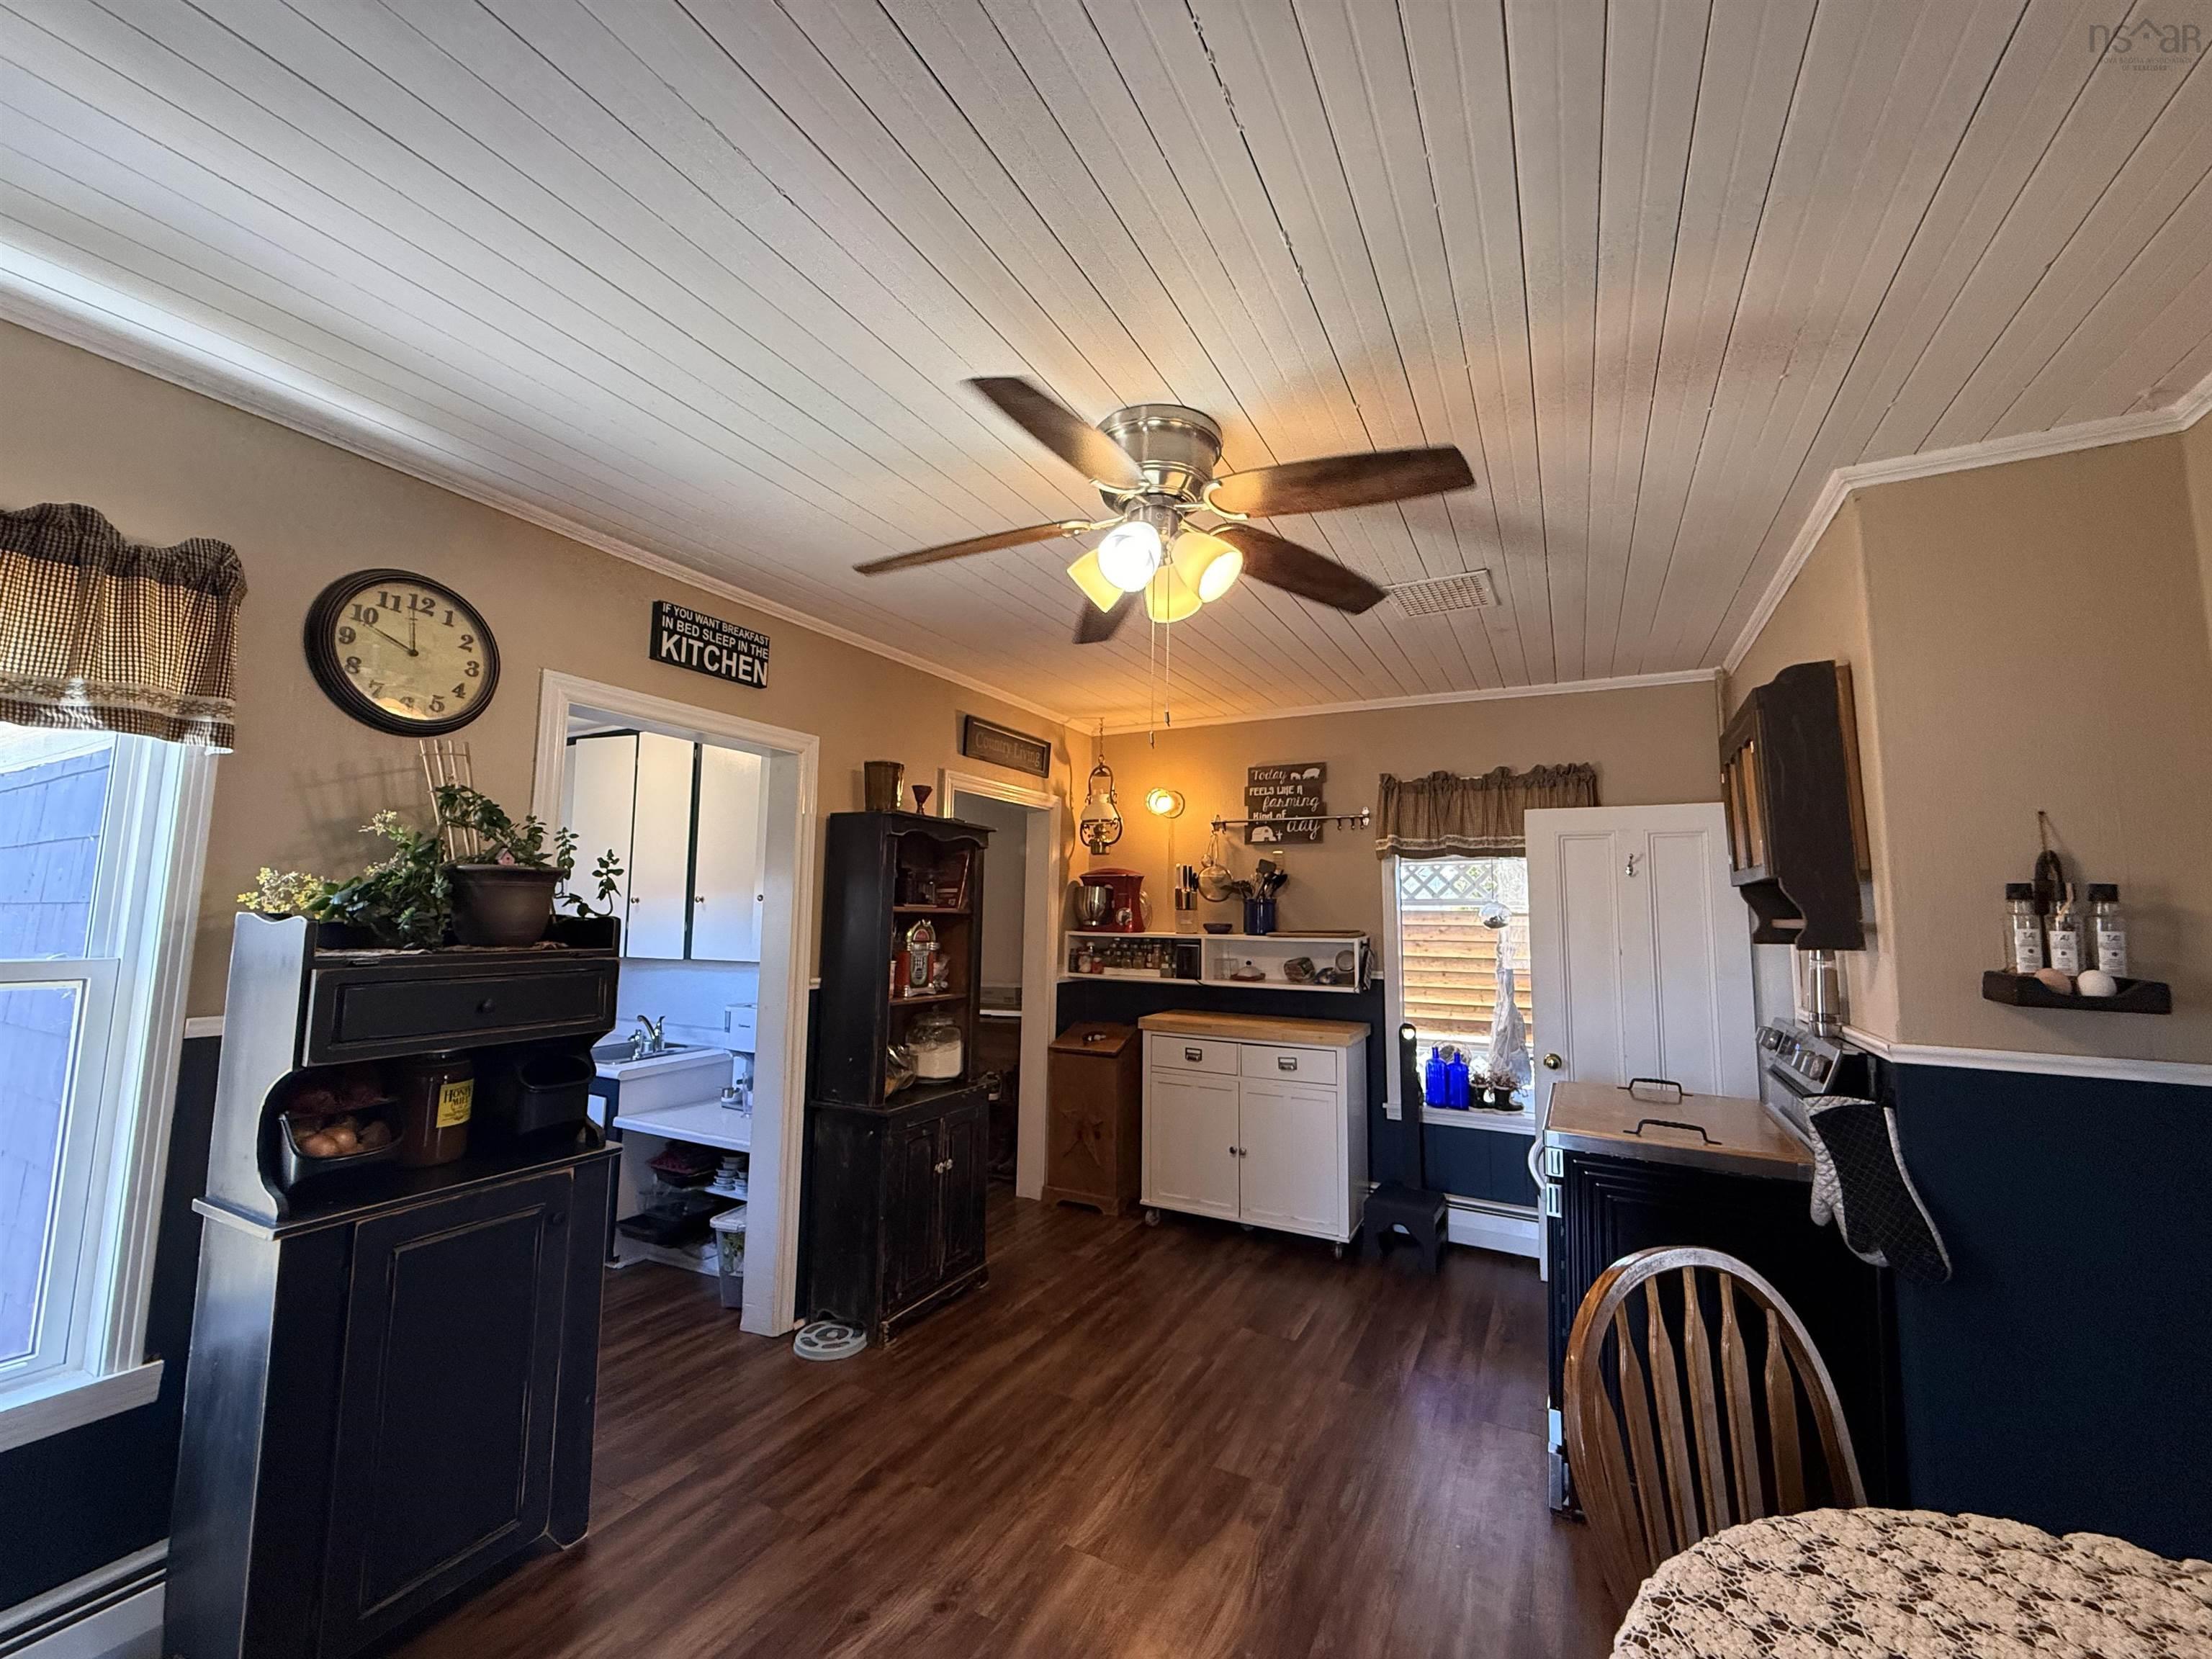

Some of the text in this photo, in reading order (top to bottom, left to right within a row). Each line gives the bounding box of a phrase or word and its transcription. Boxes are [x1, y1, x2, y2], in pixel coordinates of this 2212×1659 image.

[377, 591, 402, 613] 11
[408, 593, 436, 616] 12
[350, 604, 379, 625] 10
[442, 610, 454, 627] 1
[662, 603, 770, 647] IF YOU WANT BREAKFAST
[338, 626, 356, 644] 9
[458, 634, 474, 652] 2
[662, 615, 769, 660] IN BED SLEEP IN THE
[344, 656, 361, 674] 8
[661, 630, 768, 686] KITCHEN
[464, 661, 480, 677] 3
[369, 680, 385, 697] 7
[451, 683, 466, 698] 4
[429, 695, 445, 712] 5
[975, 732, 1041, 768] Country Living
[1251, 768, 1287, 784] Today
[1249, 785, 1303, 796] FEELS LIKE A
[1262, 796, 1320, 812] farming
